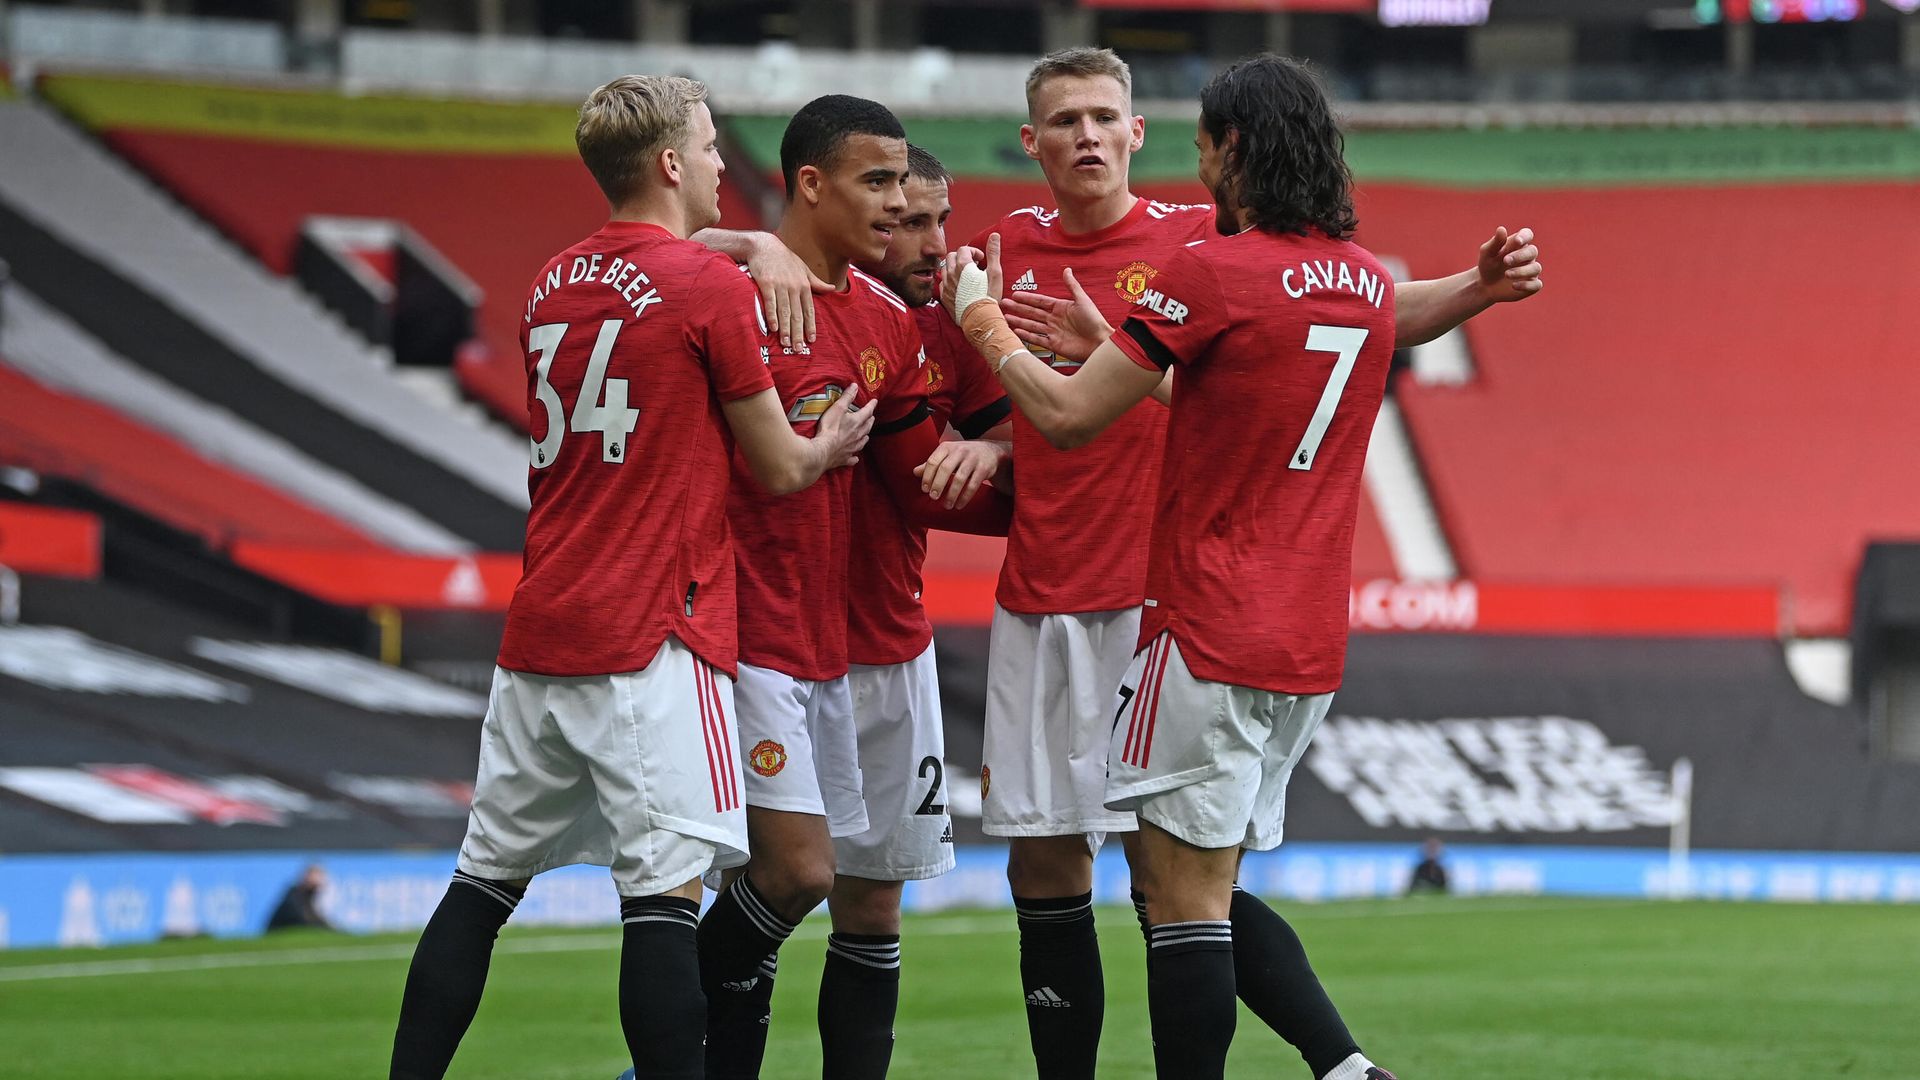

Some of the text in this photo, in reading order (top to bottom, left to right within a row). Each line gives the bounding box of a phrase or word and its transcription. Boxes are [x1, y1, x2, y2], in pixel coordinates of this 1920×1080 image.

[524, 253, 663, 324] VAN DE BEEK
[1011, 282, 1038, 291] adidas
[1281, 259, 1386, 309] CAVANI
[528, 318, 641, 470] 34
[1287, 323, 1370, 471] 7
[1110, 684, 1135, 741] 7
[914, 755, 950, 816] 2
